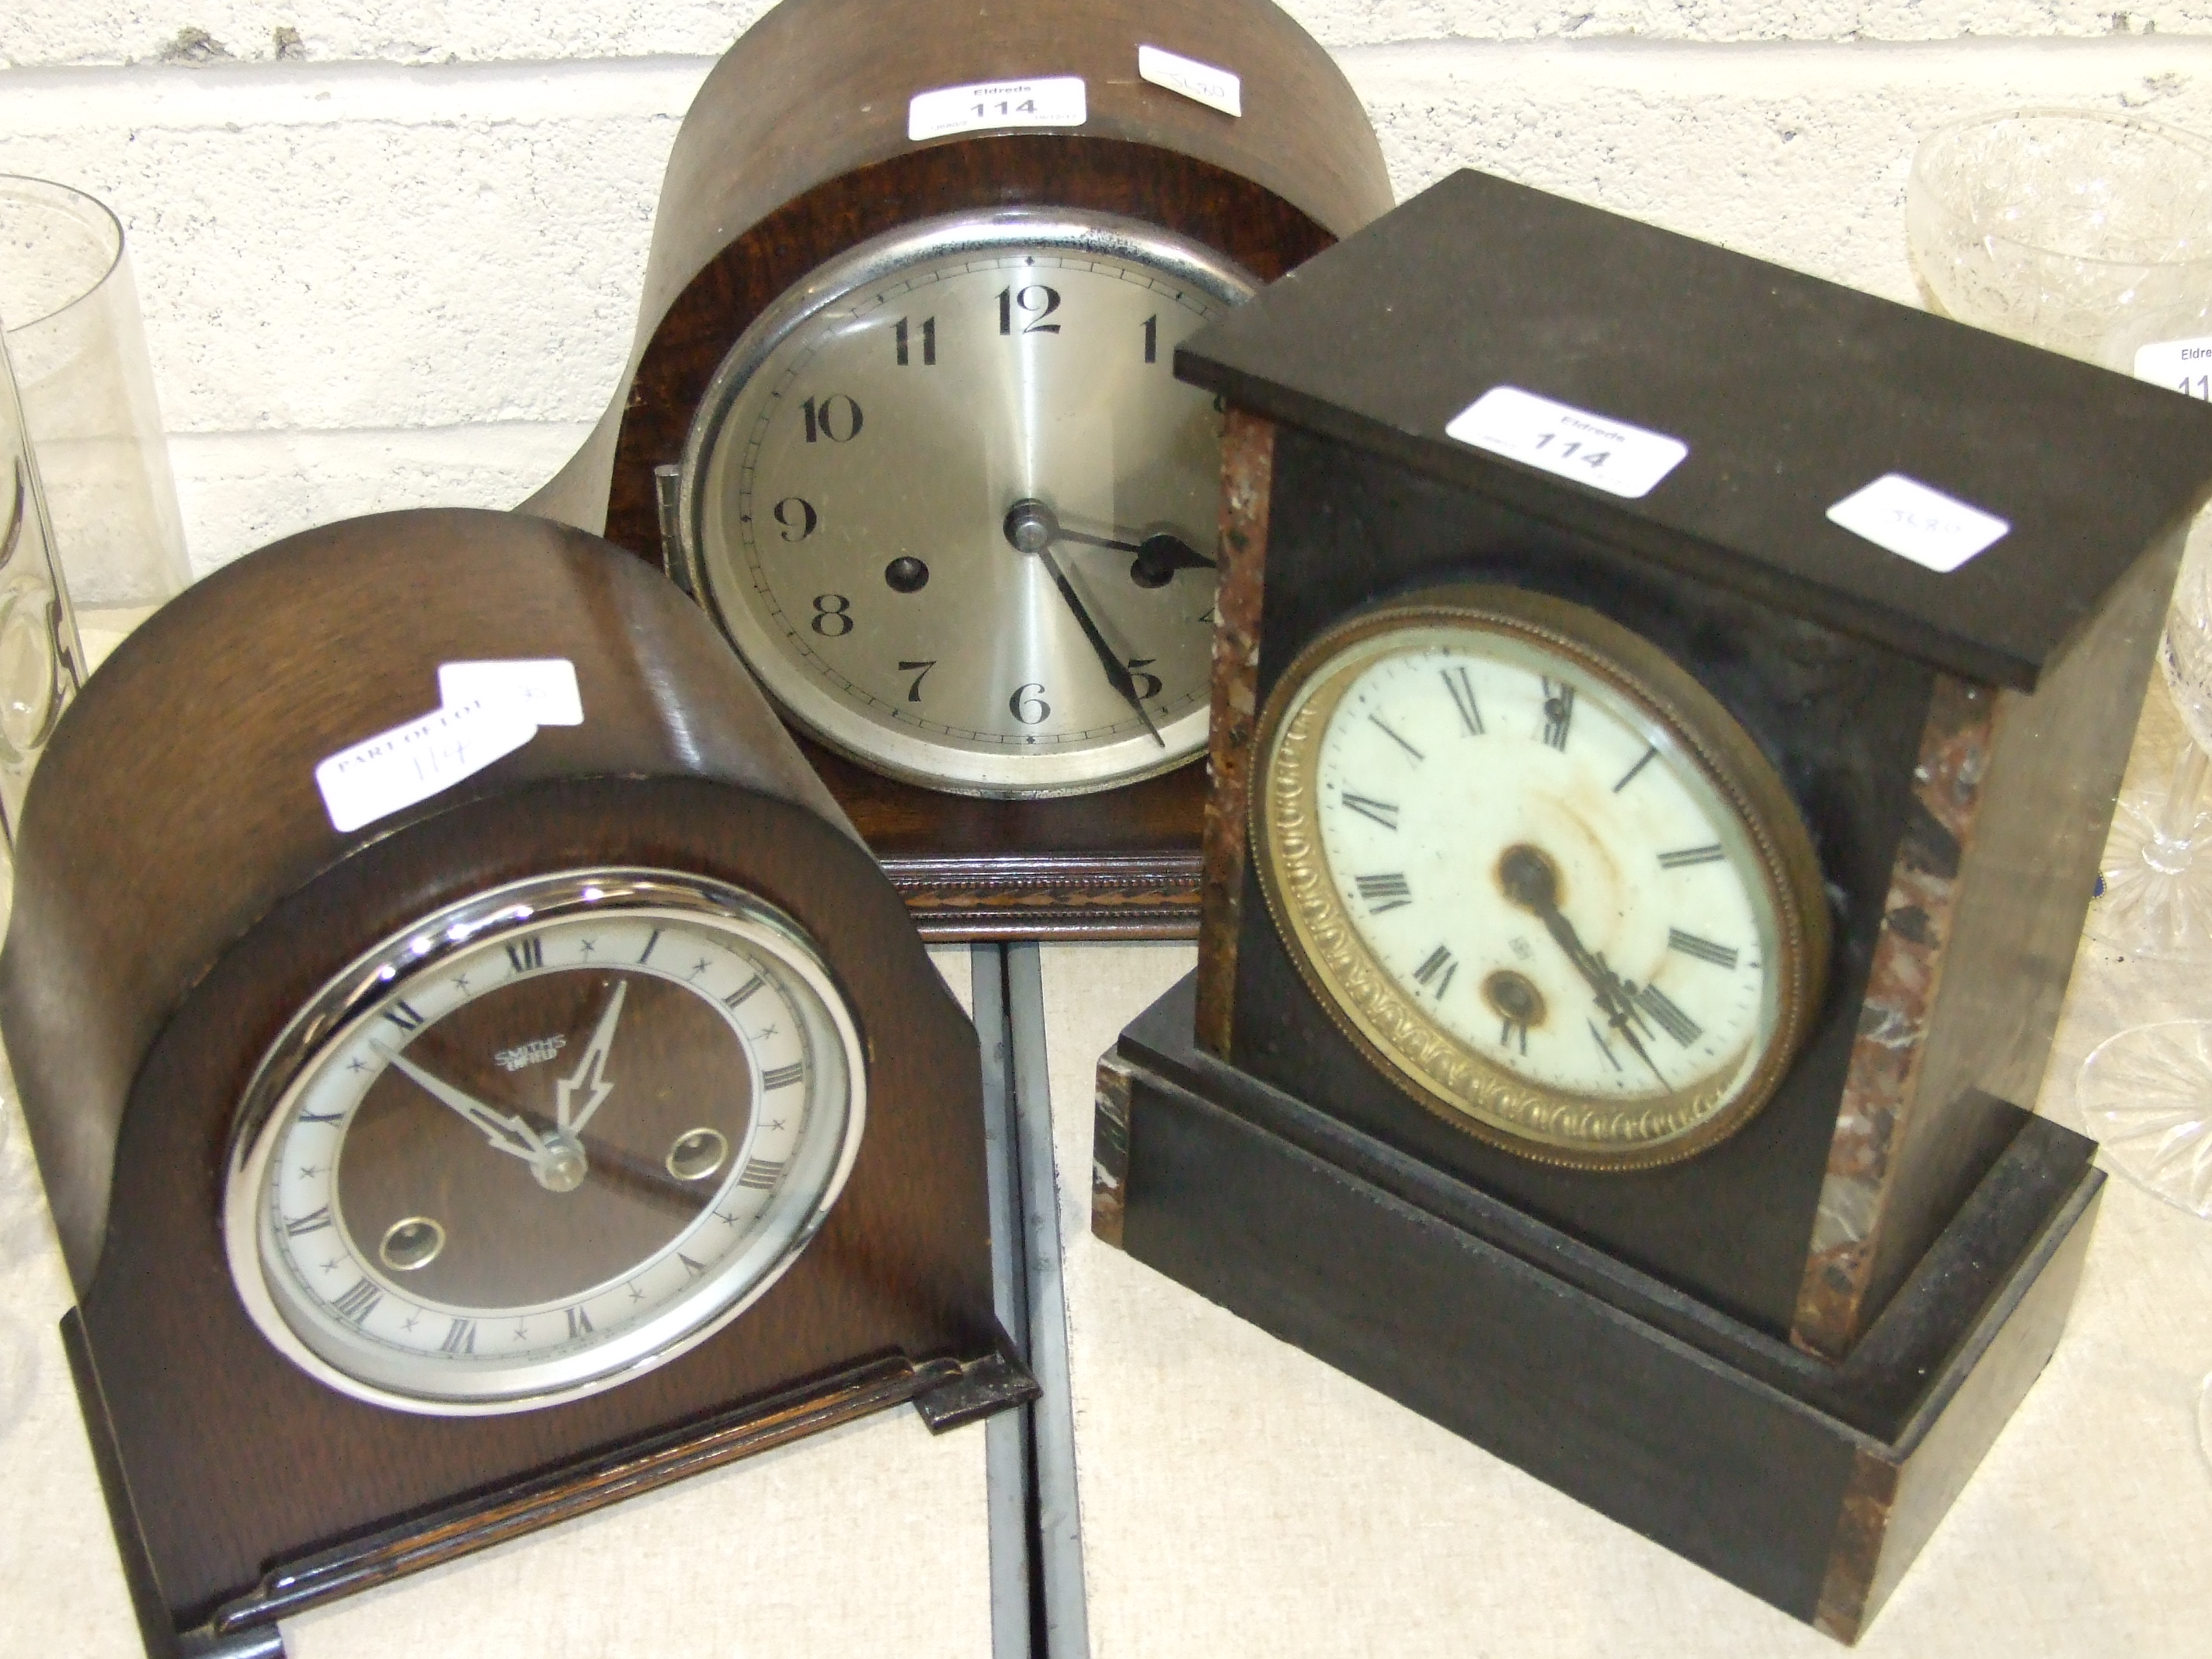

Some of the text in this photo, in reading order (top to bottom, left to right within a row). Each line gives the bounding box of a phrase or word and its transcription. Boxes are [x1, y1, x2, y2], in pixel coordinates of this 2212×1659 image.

[969, 99, 1038, 118] 114
[973, 85, 1032, 96] Eldreds
[996, 284, 1062, 336] 12
[892, 315, 937, 366] 11
[1140, 313, 1157, 363] 1
[800, 393, 864, 443] 10
[1560, 415, 1627, 443] Eldreds
[1534, 432, 1612, 469] 114
[773, 497, 818, 542] 9
[811, 594, 854, 637] 8
[898, 660, 937, 702] 7
[1125, 659, 1163, 700] 5
[1009, 683, 1052, 725] 6
[404, 723, 433, 743] OF
[1668, 927, 1739, 972] III
[494, 1035, 567, 1066] SMITHS
[762, 1061, 804, 1091] III
